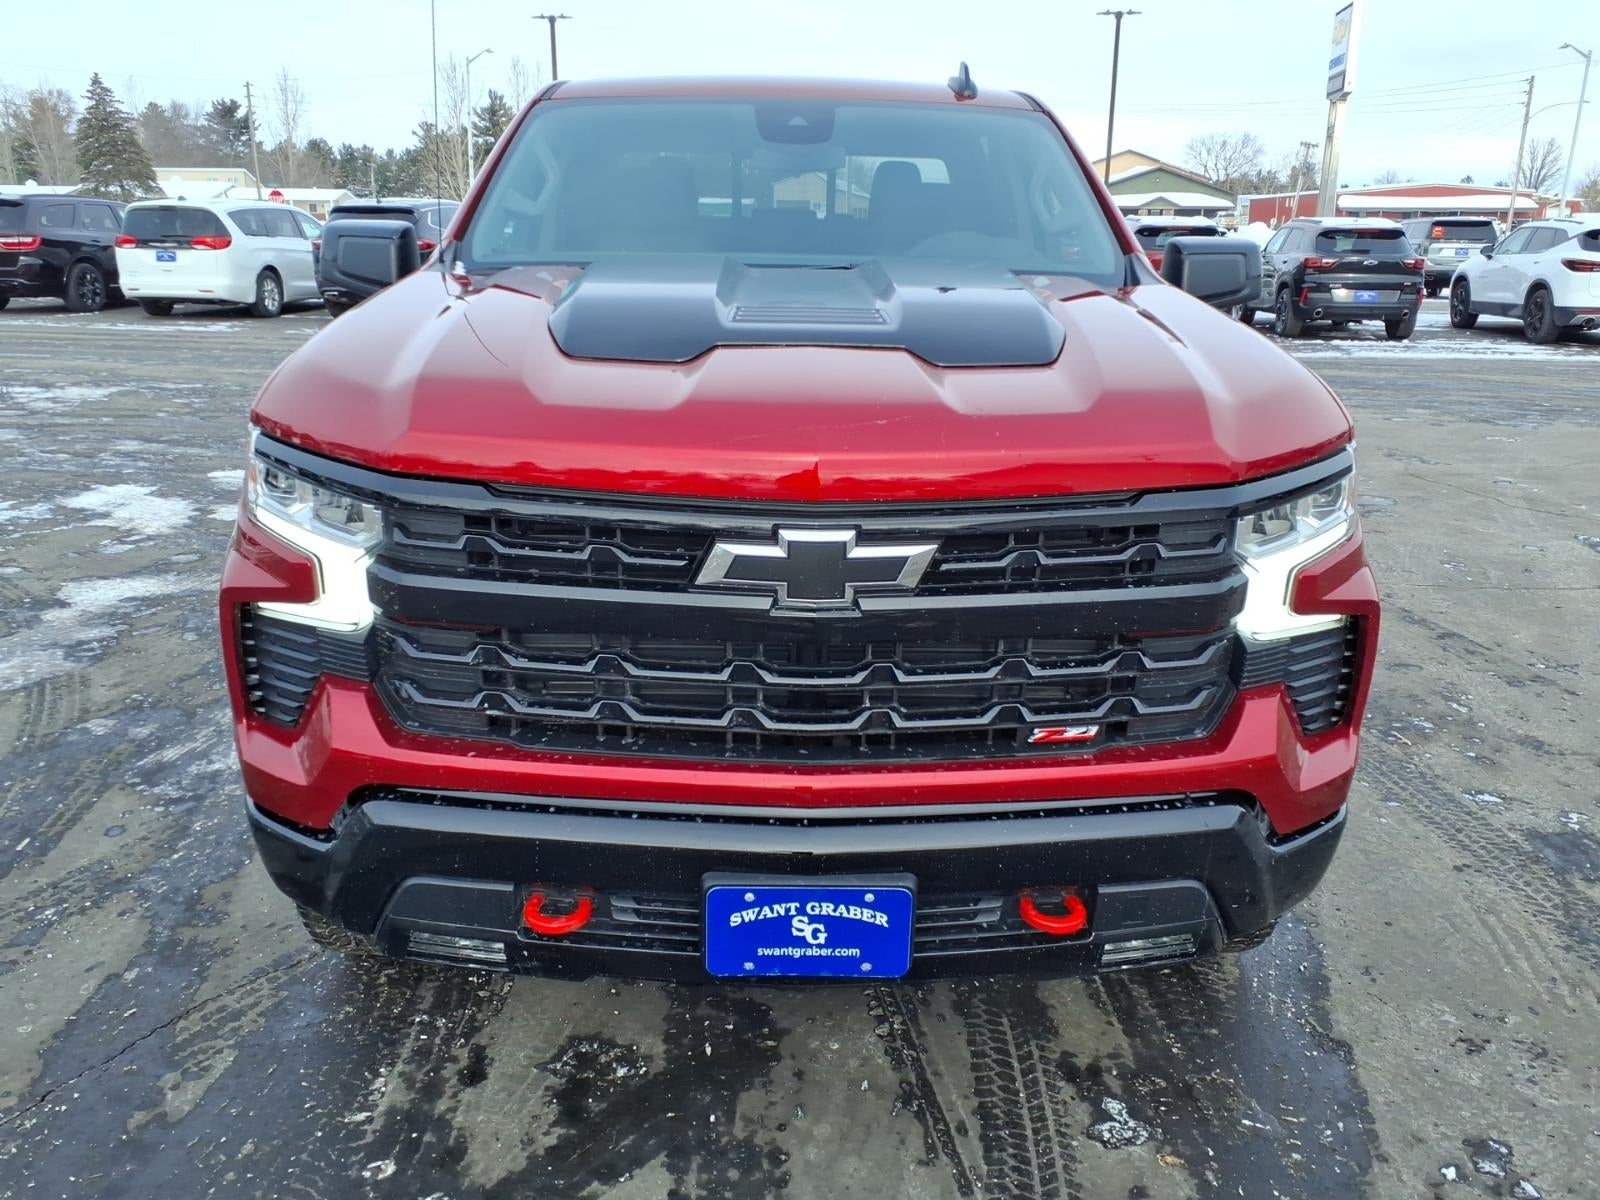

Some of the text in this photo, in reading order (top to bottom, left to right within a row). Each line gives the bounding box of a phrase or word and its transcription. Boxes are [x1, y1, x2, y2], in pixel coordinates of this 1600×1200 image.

[729, 901, 889, 928] SWANT GRABER
[791, 915, 828, 944] SG
[757, 946, 860, 958] swantgraber.com
